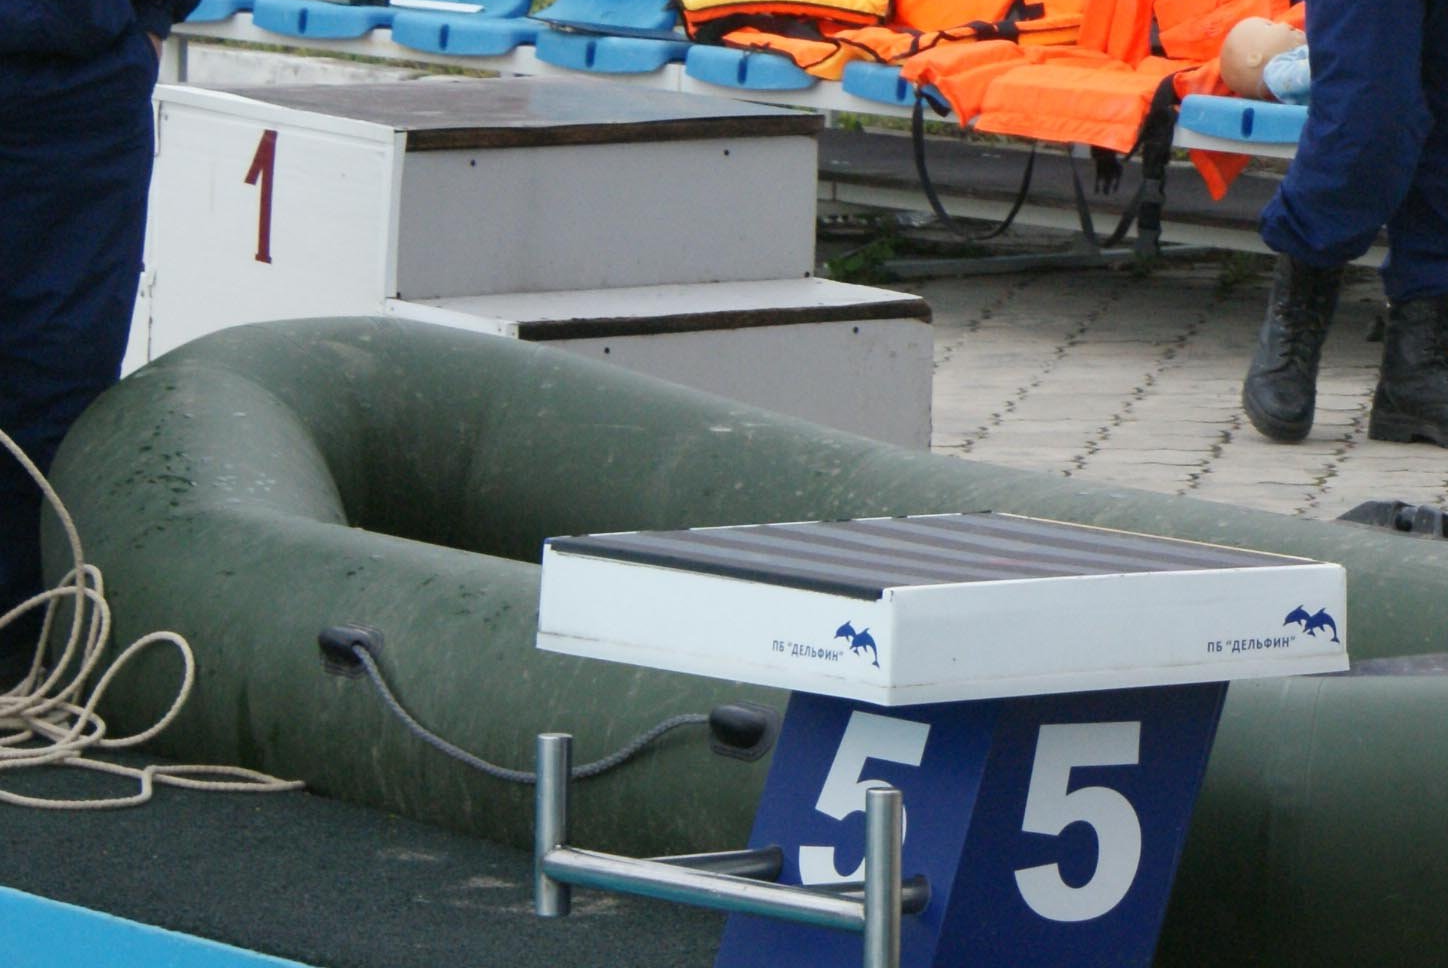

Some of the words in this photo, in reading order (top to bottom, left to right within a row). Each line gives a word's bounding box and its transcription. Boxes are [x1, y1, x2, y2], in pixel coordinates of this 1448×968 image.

[244, 129, 278, 264] 1
[772, 640, 785, 652] ПБ
[1207, 641, 1223, 652] ПБ
[798, 710, 931, 886] 5
[1014, 721, 1142, 922] 5
